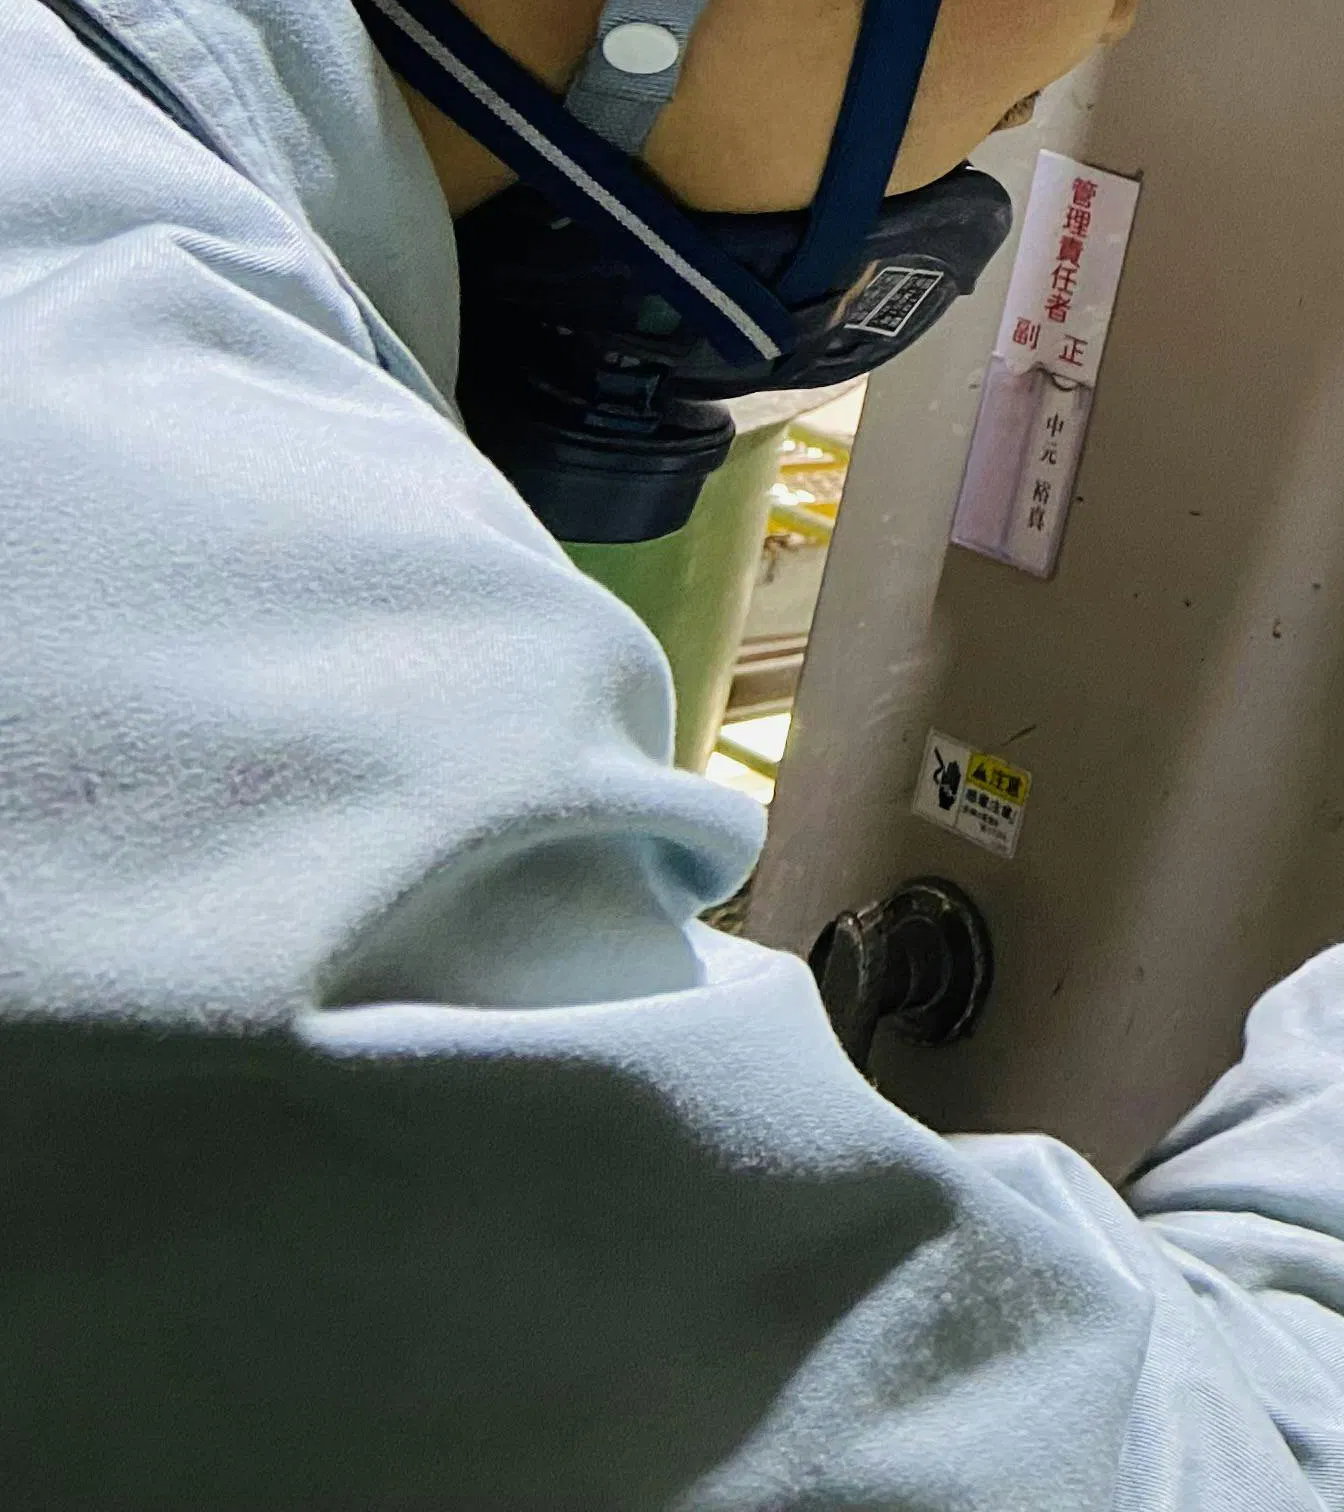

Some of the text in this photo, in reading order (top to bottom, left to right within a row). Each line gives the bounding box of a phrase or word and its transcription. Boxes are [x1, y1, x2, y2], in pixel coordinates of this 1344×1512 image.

[1044, 177, 1099, 324] 管理責任者
[1011, 316, 1089, 367] 副 正
